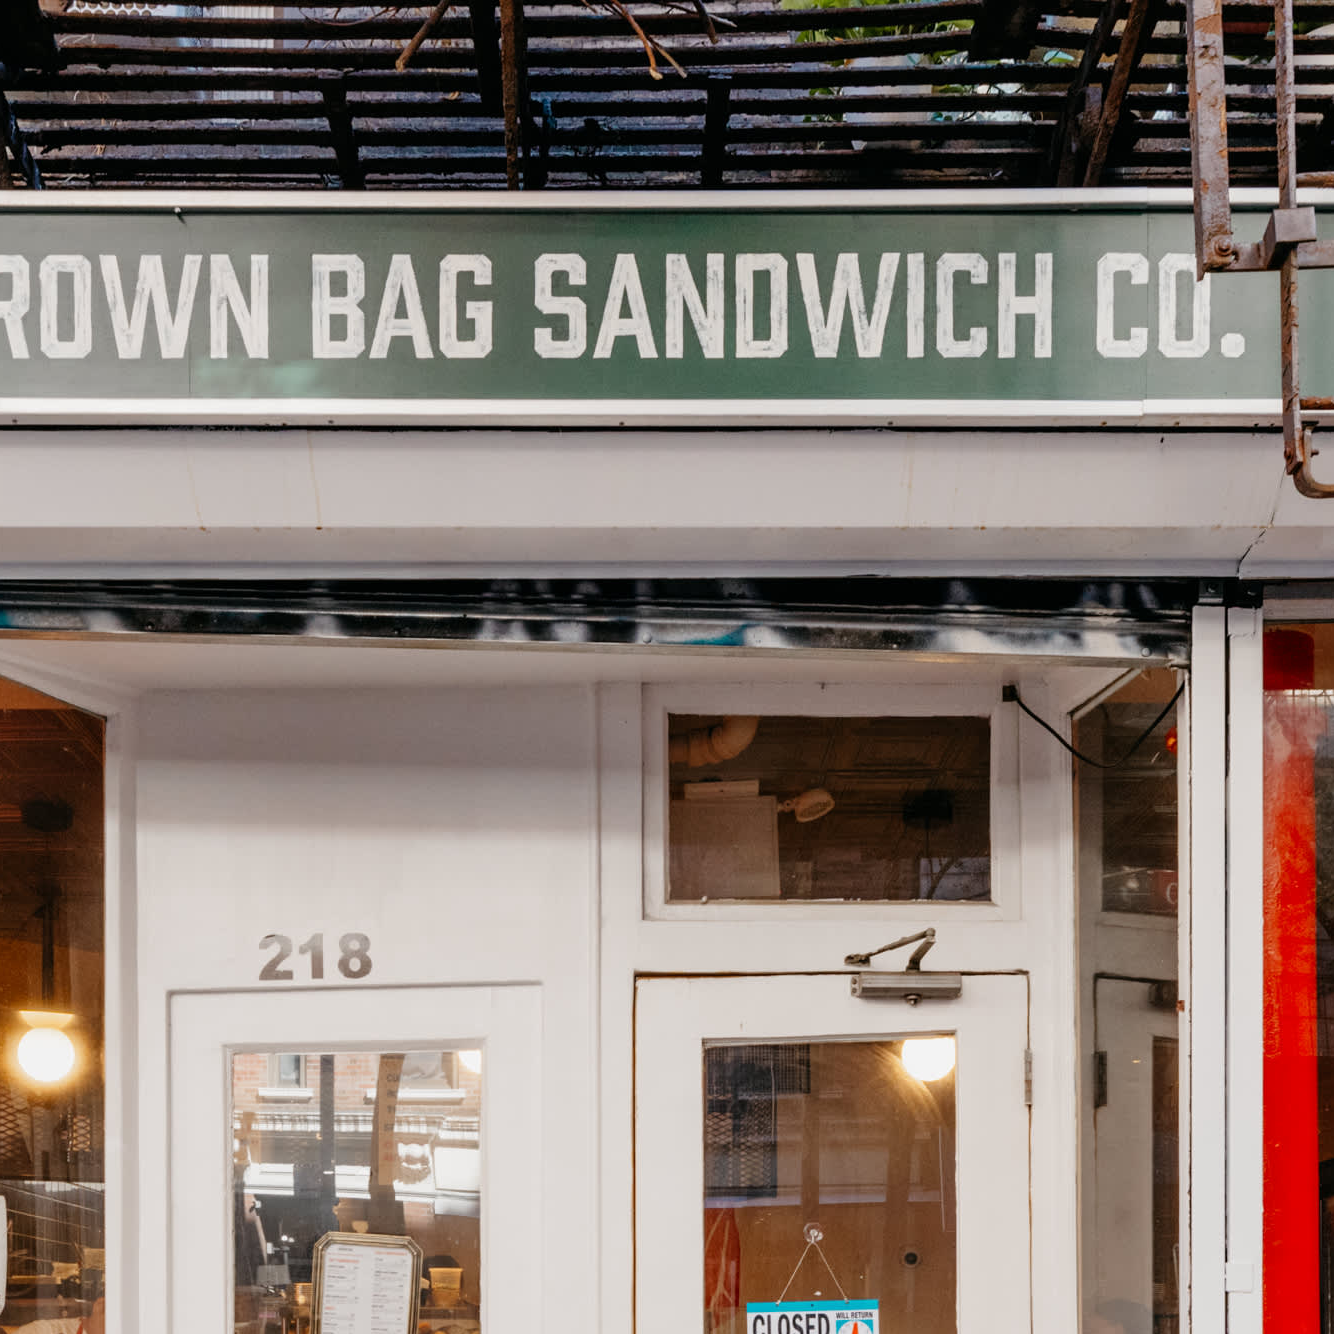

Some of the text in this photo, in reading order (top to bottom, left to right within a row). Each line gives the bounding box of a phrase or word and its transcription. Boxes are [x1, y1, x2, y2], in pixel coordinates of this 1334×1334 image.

[312, 254, 493, 359] BAG
[534, 253, 1054, 359] SANDWICH
[1096, 253, 1246, 358] CO.
[259, 932, 372, 980] 218
[851, 1311, 873, 1319] RETURN
